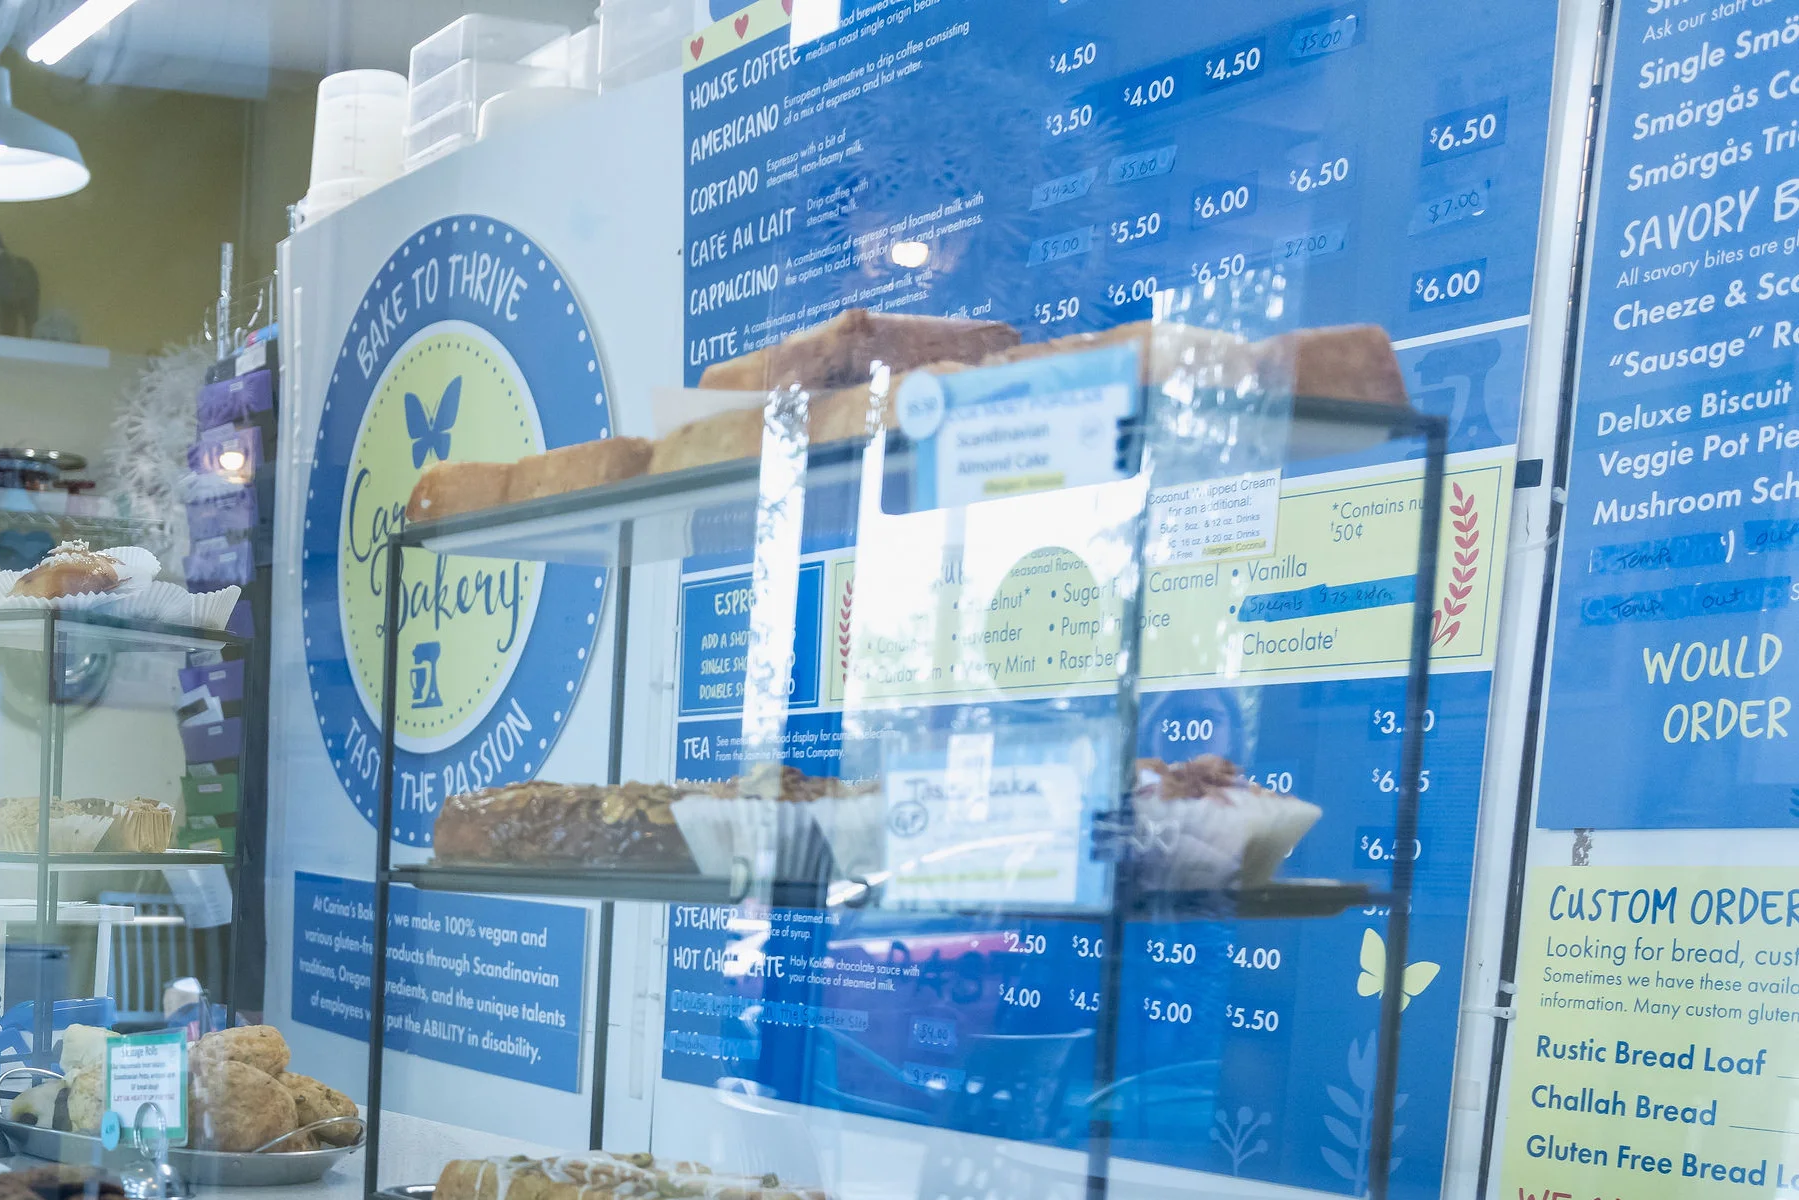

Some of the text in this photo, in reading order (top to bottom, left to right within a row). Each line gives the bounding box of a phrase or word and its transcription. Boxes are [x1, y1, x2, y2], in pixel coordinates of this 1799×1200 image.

[1642, 12, 1706, 44] Ask our
[691, 43, 802, 111] HOUSE COFFEE
[783, 20, 970, 110] European alternative to drip coffee consisting
[1049, 42, 1097, 75] $4.50
[1638, 41, 1726, 90] Single
[1046, 104, 1093, 137] $3.50
[1123, 75, 1174, 108] $4.00
[1205, 47, 1261, 82] $4.50
[1632, 84, 1760, 141] Smörgås
[691, 104, 779, 166] AMERICANO
[1430, 113, 1497, 152] $6.50
[1627, 137, 1753, 192] Smörgås
[691, 167, 758, 217] CORTADO
[1193, 157, 1349, 221] $6.00 $6.50
[691, 207, 797, 268] CAFÉ AU LAIT
[1110, 212, 1161, 246] $5.50
[1619, 185, 1760, 258] SAVORY
[1615, 241, 1778, 289] All savory bites are
[691, 264, 779, 316] CAPPUCCINO
[1034, 296, 1080, 326] $5.50
[1414, 269, 1480, 303] $6.00
[1613, 279, 1747, 331] Cheeze &
[356, 250, 530, 381] BAKE TO THRIVE
[690, 326, 738, 367] LATTÉ
[1597, 379, 1793, 437] Deluxe Biscuit
[1598, 440, 1694, 480] Veggie
[1702, 432, 1750, 462] Pot
[1241, 477, 1276, 491] Cream
[1592, 487, 1742, 526] Mushroom
[1150, 553, 1304, 593] Caramel Vanilla
[1006, 654, 1036, 673] Mint
[1642, 633, 1783, 684] WOULD
[1161, 719, 1214, 742] $3.00
[1663, 696, 1792, 744] ORDER
[400, 697, 534, 815] THE PASSION
[683, 736, 710, 760] TEA
[1549, 884, 1678, 926] CUSTOM
[393, 914, 410, 928] we
[411, 913, 441, 933] make
[445, 915, 477, 938] 100%
[479, 926, 518, 948] vegan
[521, 928, 547, 949] and
[1003, 931, 1281, 971] $2.50 $3.50 $4.00
[1546, 935, 1746, 970] Looking for bread,
[304, 928, 560, 988] various through Scandinavian
[673, 946, 701, 970] HOT
[836, 960, 920, 977] chocolate sauce with
[1542, 966, 1742, 993] Sometimes we have these
[339, 965, 371, 990] Oregon
[432, 987, 453, 1007] and
[455, 991, 475, 1009] the
[477, 998, 520, 1022] unique
[522, 1002, 566, 1028] talents
[998, 983, 1279, 1032] $4.00 $5.00 $5.50
[1539, 992, 1742, 1021] information. Many custom
[310, 991, 542, 1066] of employees put the ABILITY in disability.
[1536, 1034, 1768, 1078] Rustic Bread Loaf
[1531, 1084, 1718, 1127] Challah Bread
[1525, 1133, 1768, 1187] Gluten Free Bread
